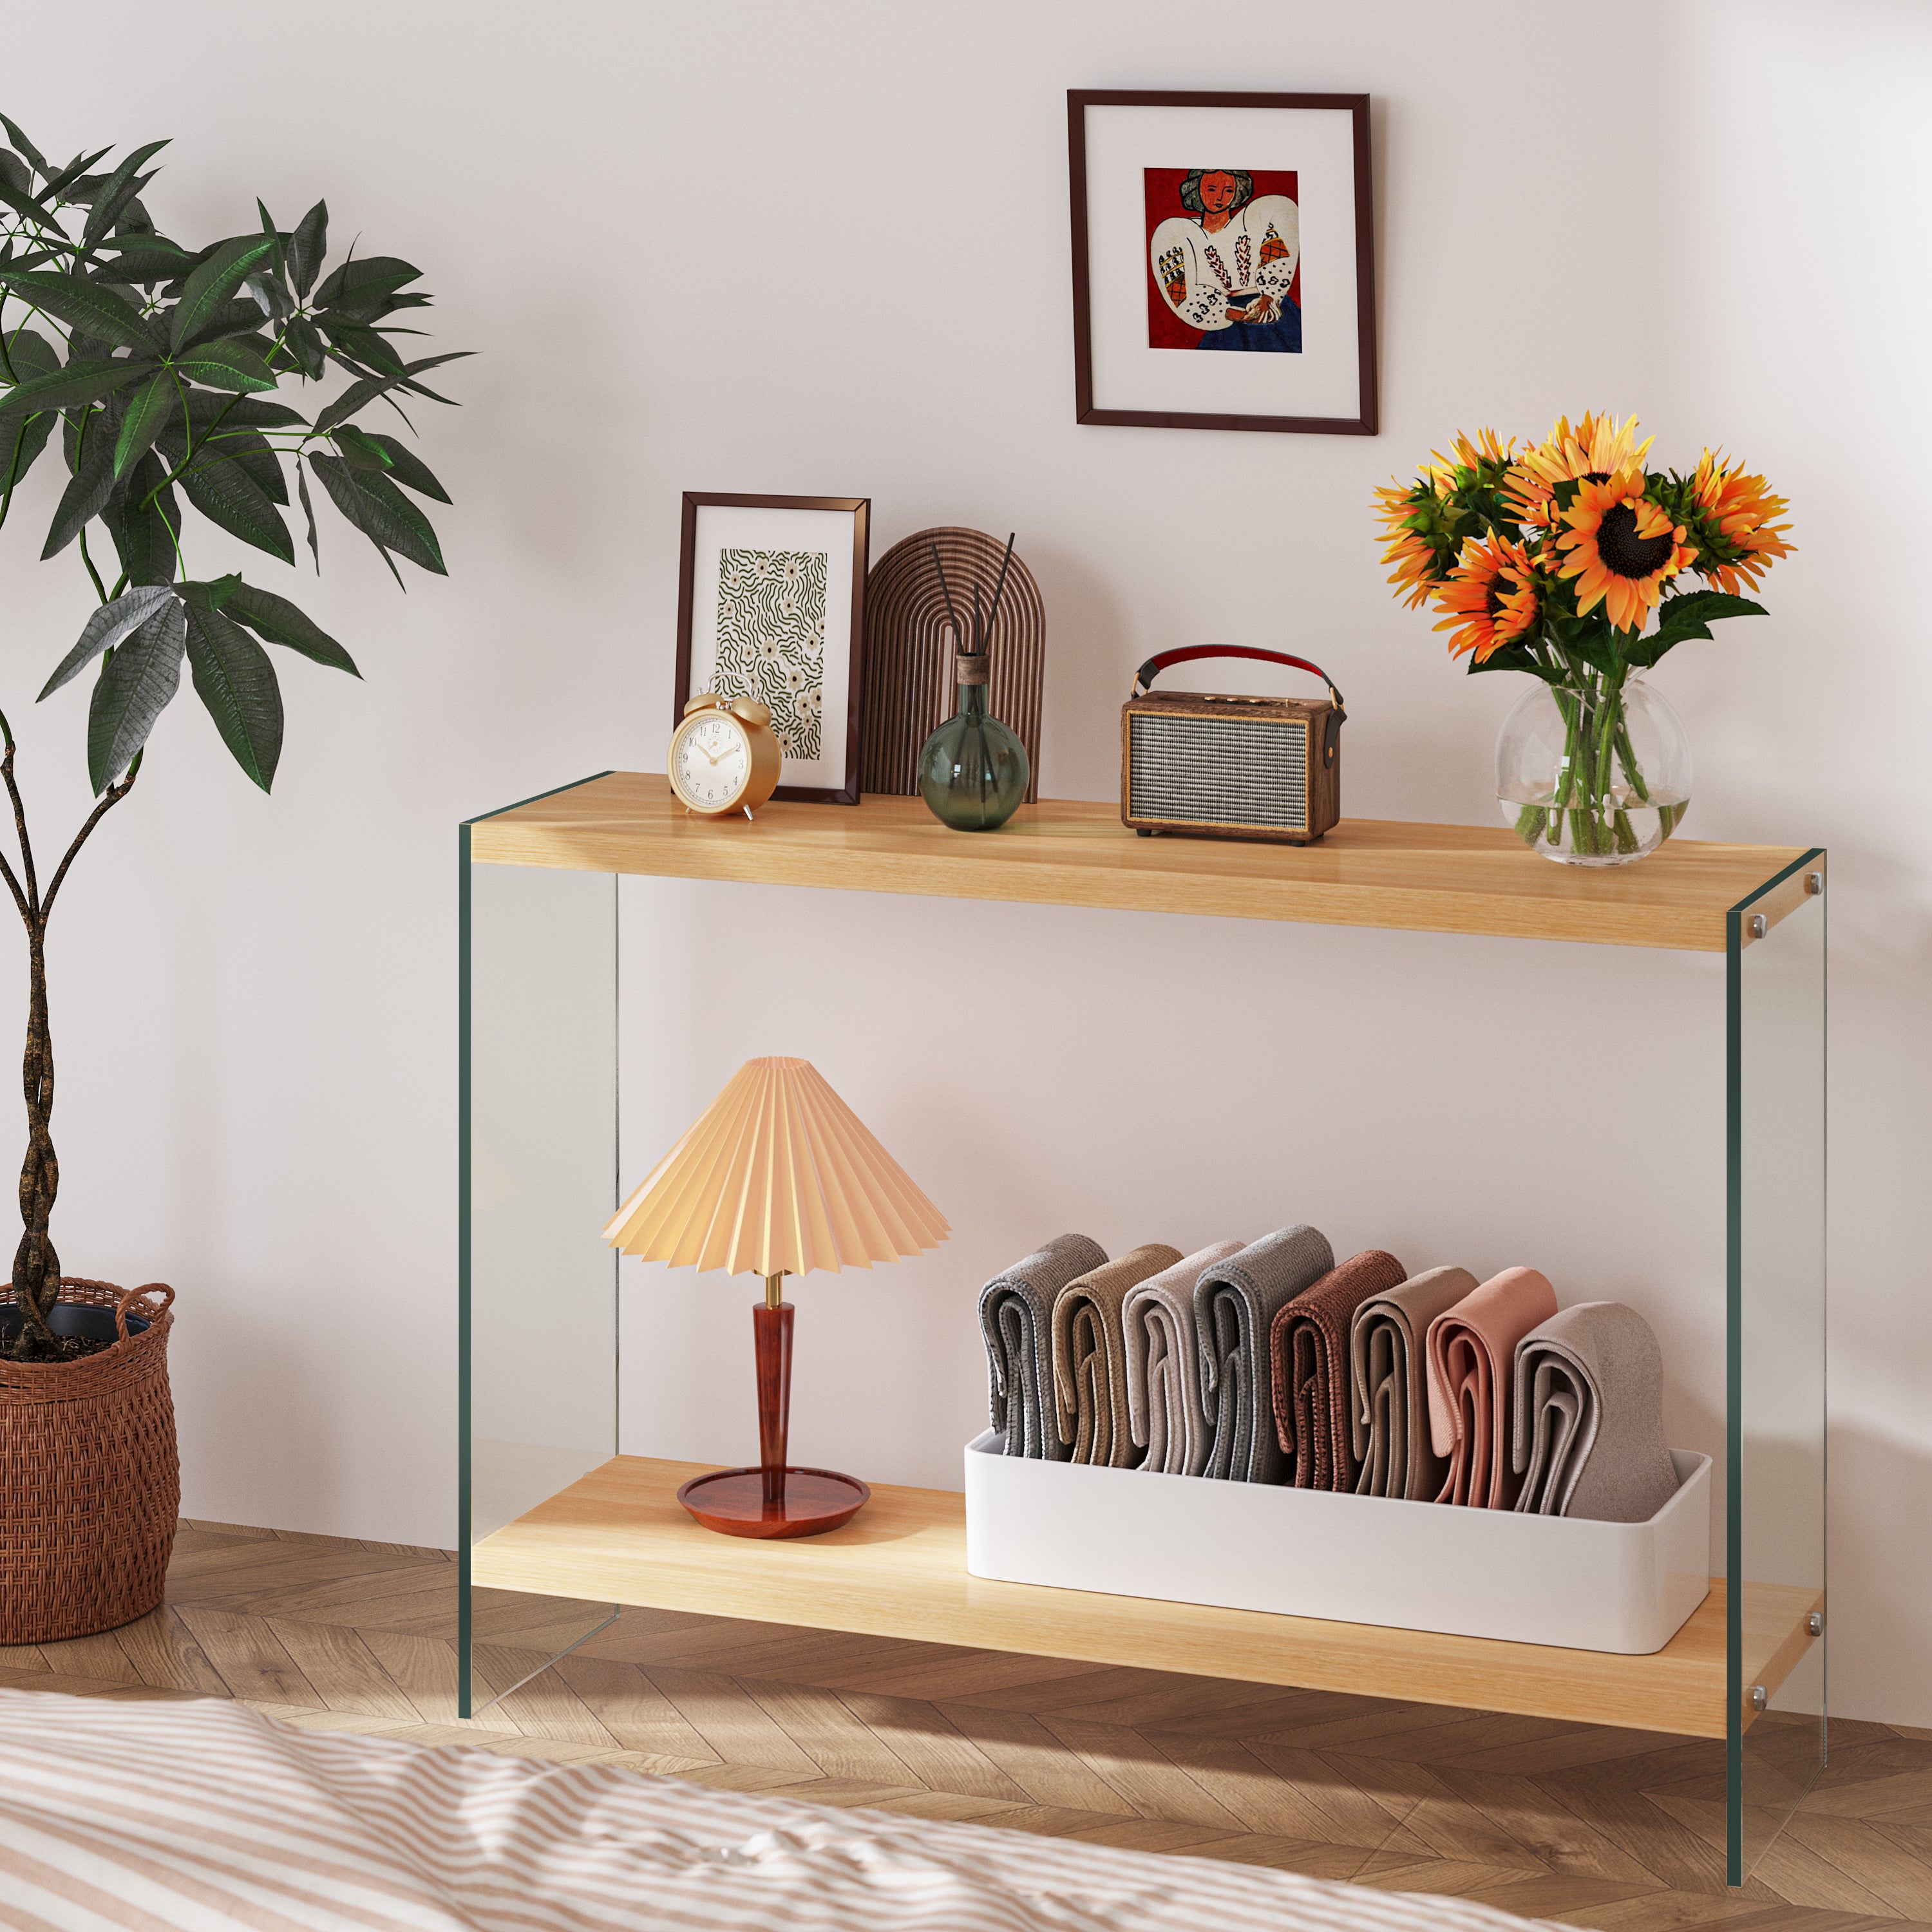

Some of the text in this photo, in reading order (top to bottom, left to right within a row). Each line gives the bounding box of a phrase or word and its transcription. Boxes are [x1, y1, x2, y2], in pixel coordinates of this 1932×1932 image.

[700, 726, 706, 736] 11
[712, 723, 720, 733] 12
[689, 737, 696, 747] 10
[735, 743, 741, 752] 2
[683, 753, 688, 762] 9
[739, 759, 744, 769] 3
[685, 770, 690, 780] 8
[734, 777, 737, 786] 4
[696, 783, 700, 793] 7
[723, 786, 728, 796] 5
[708, 790, 713, 799] 6
